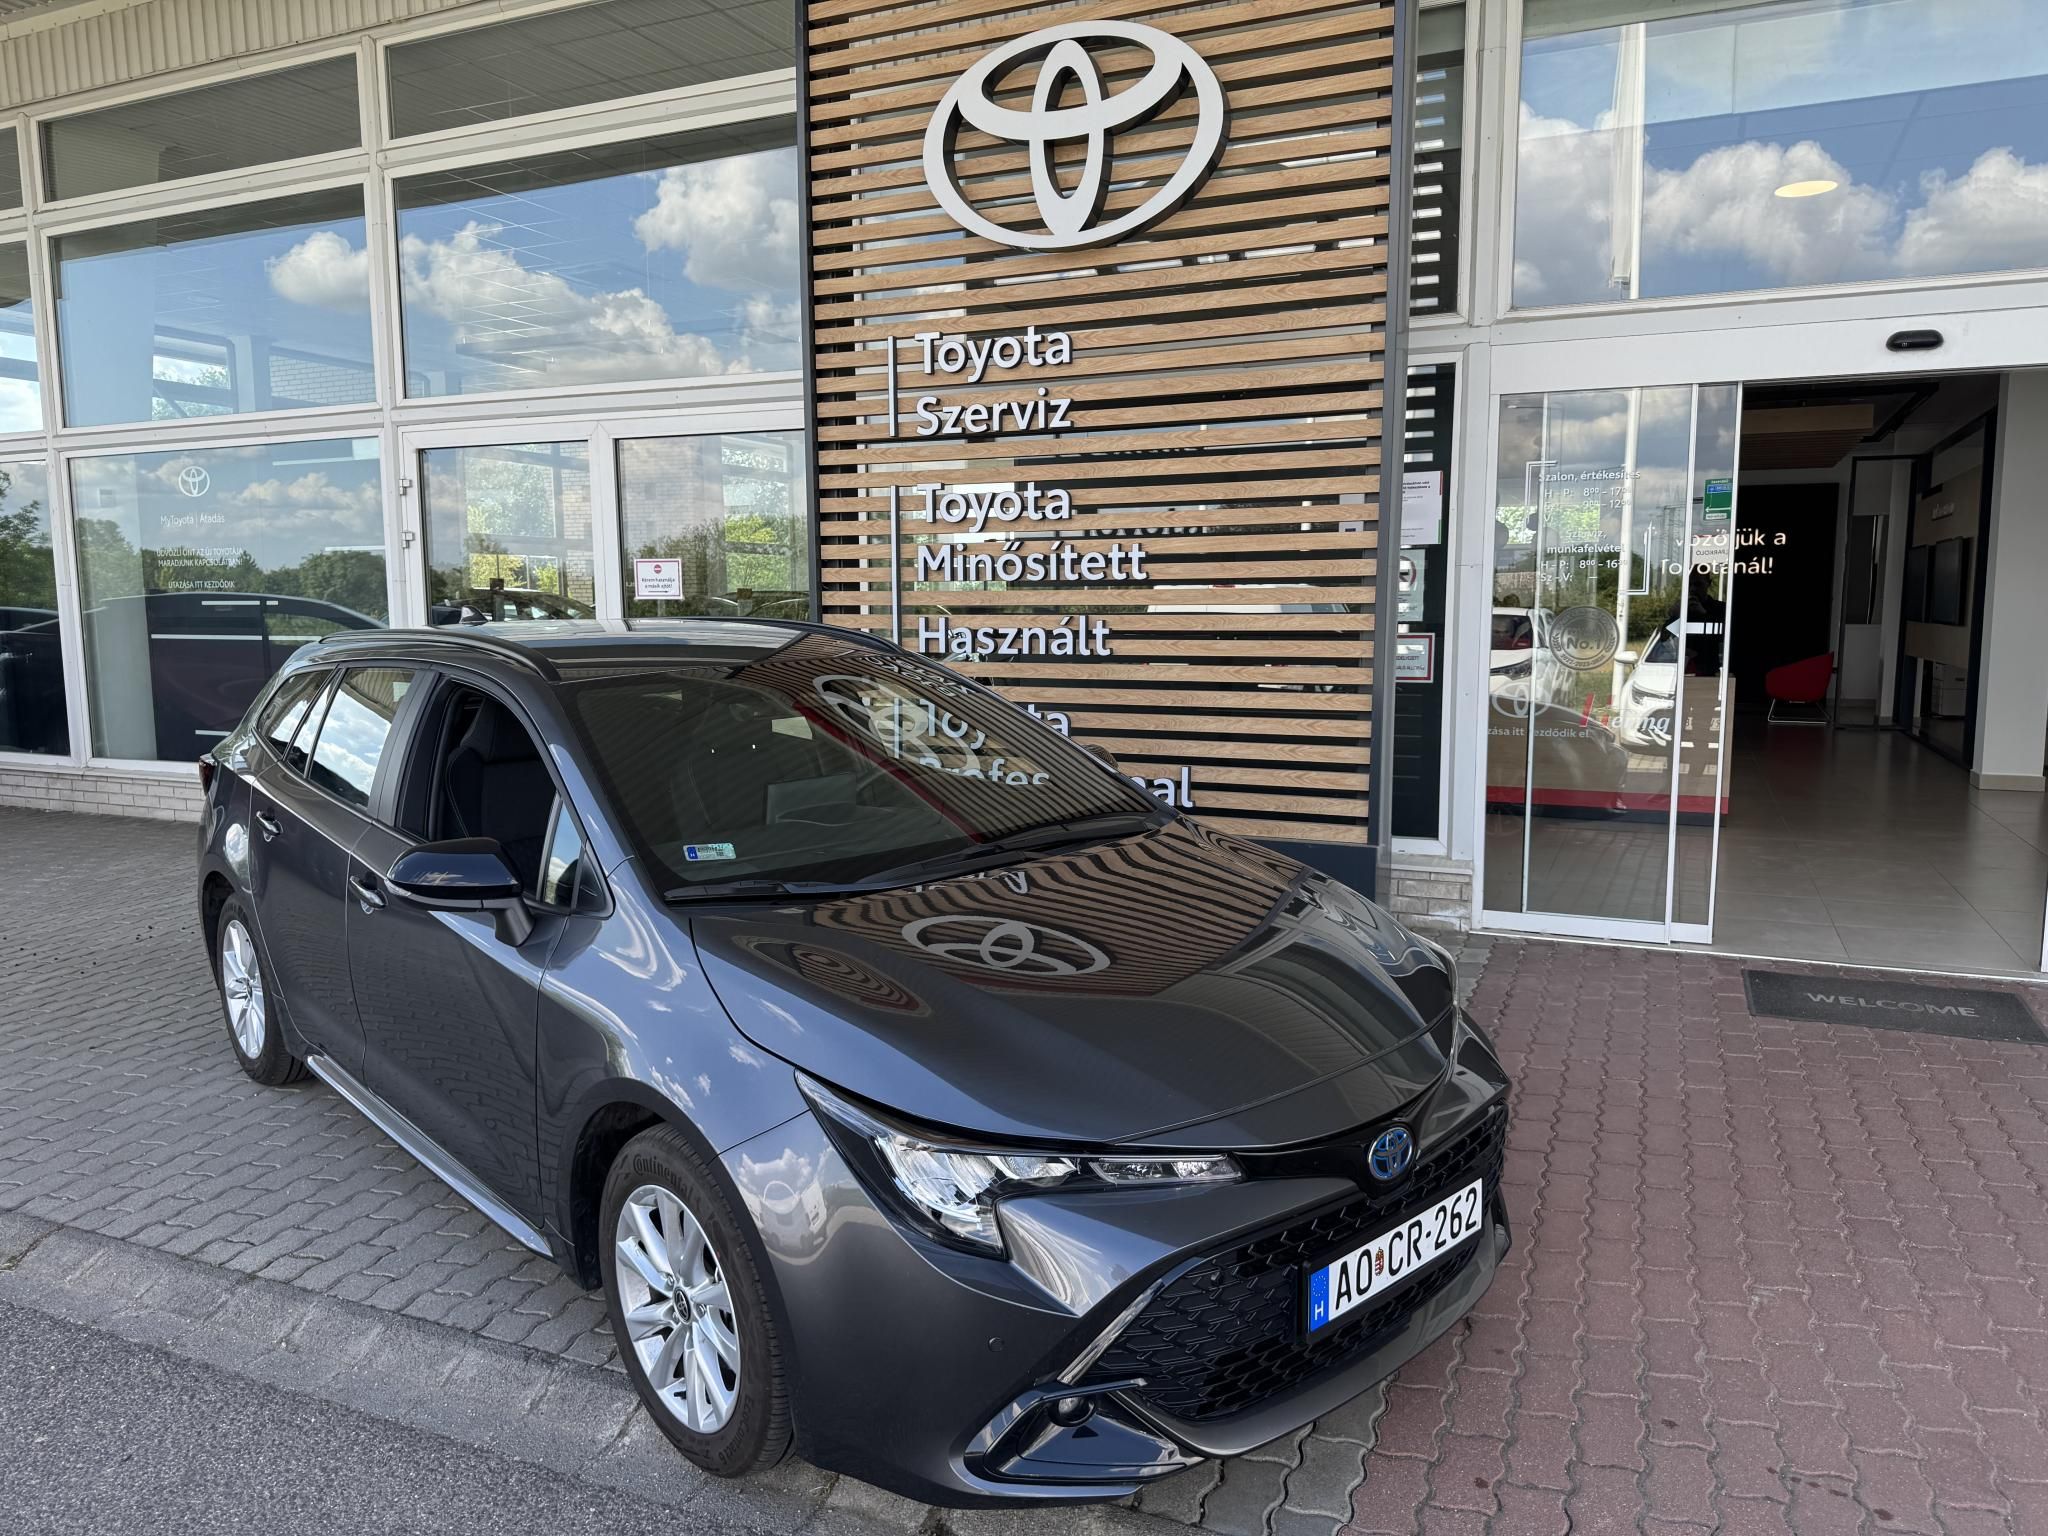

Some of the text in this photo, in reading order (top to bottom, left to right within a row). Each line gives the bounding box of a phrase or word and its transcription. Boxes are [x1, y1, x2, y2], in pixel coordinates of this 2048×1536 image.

[915, 326, 1072, 383] Toyota
[916, 387, 1073, 437] Szerviz
[916, 481, 1072, 533] Toyota
[1774, 532, 1787, 545] a
[917, 540, 1149, 583] Minősített
[918, 615, 1113, 656] Használt
[1533, 728, 1577, 738] ezdődik
[1804, 992, 1981, 1018] WELCOME
[1314, 1301, 1324, 1320] H
